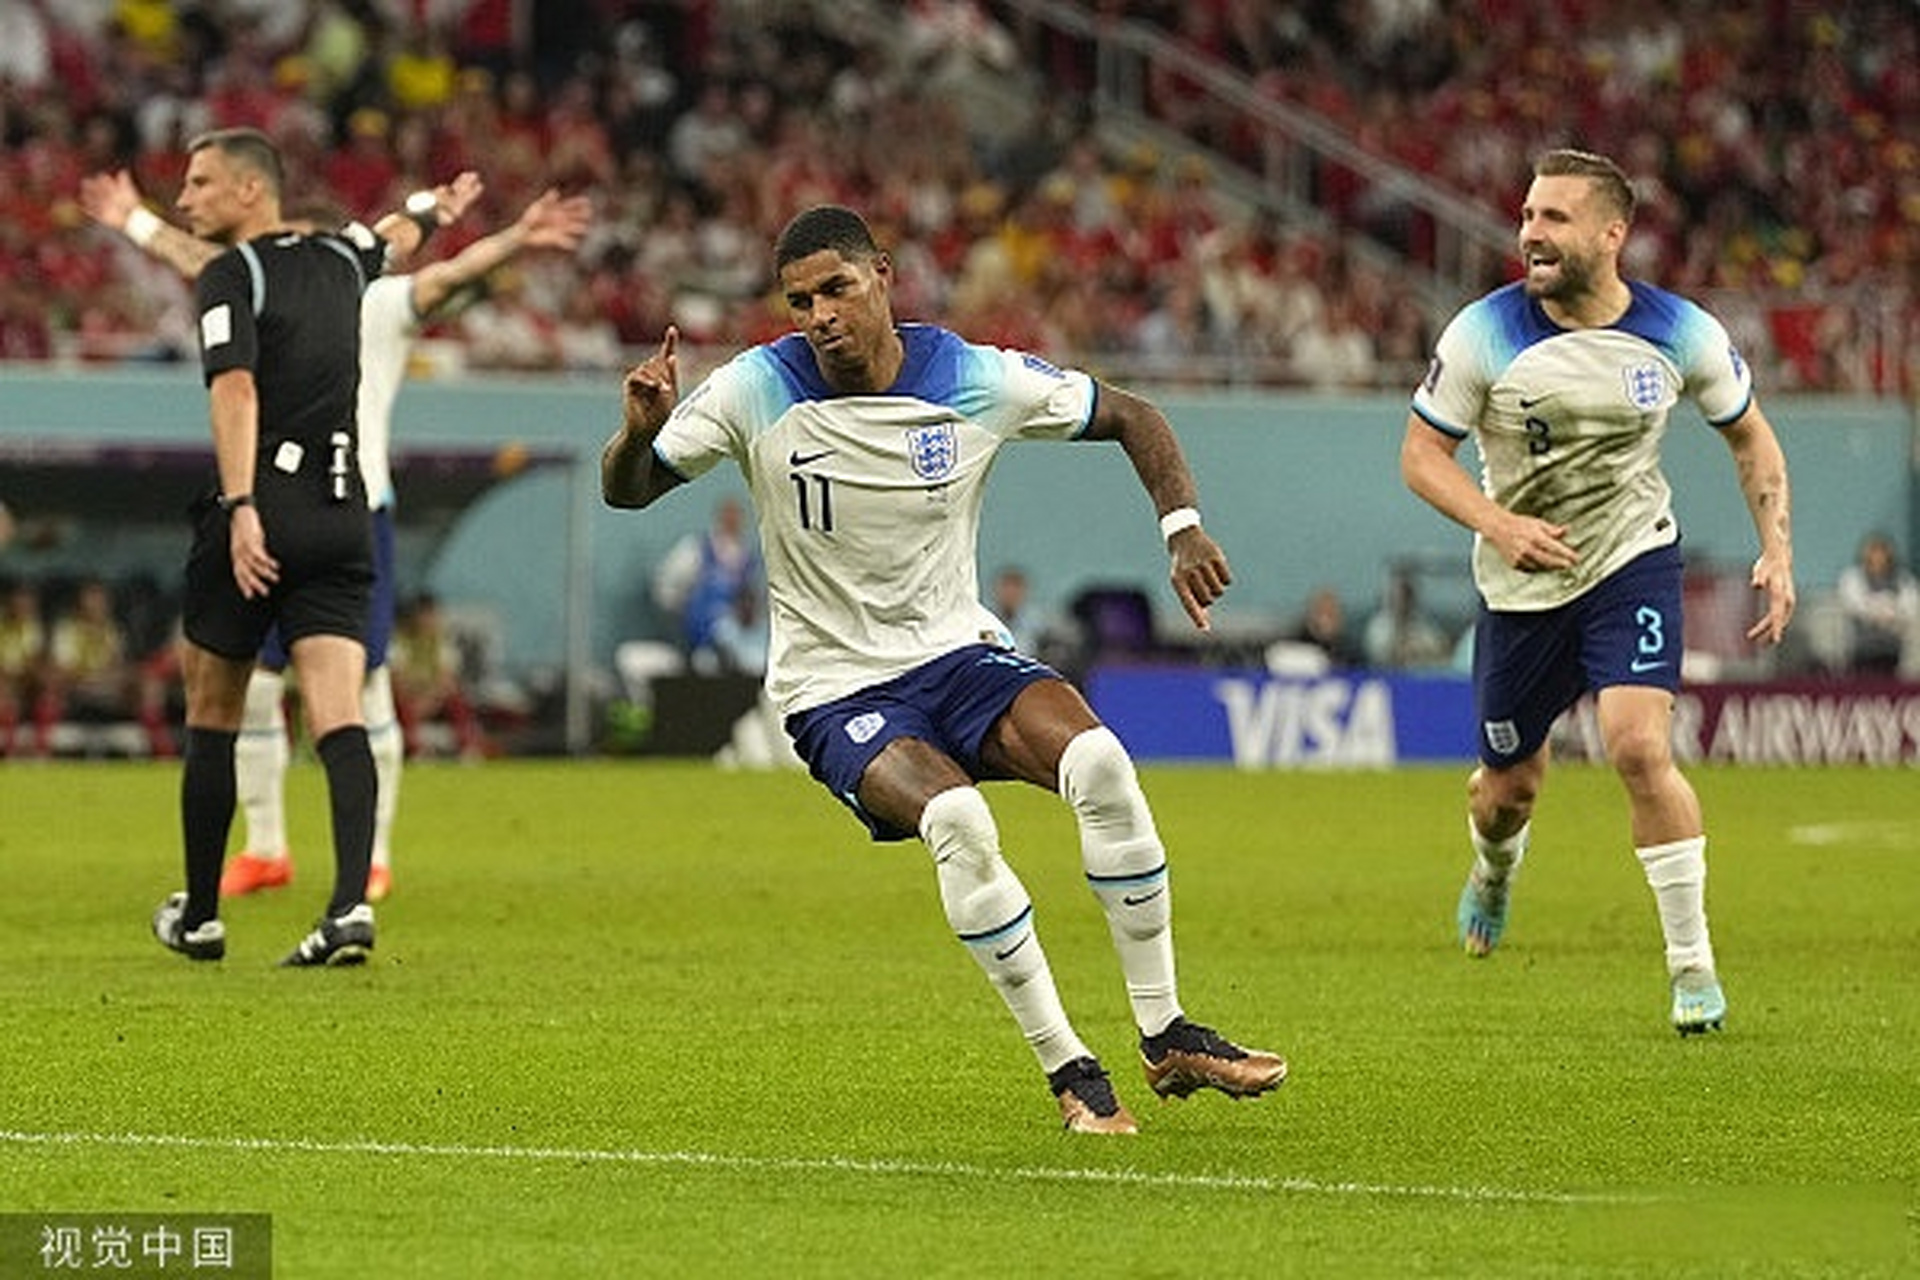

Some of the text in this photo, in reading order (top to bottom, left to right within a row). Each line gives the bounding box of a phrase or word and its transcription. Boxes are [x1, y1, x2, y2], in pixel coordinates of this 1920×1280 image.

[1525, 416, 1551, 456] 3
[789, 473, 832, 532] 11
[1636, 606, 1663, 653] 3
[1214, 680, 1398, 769] VISA
